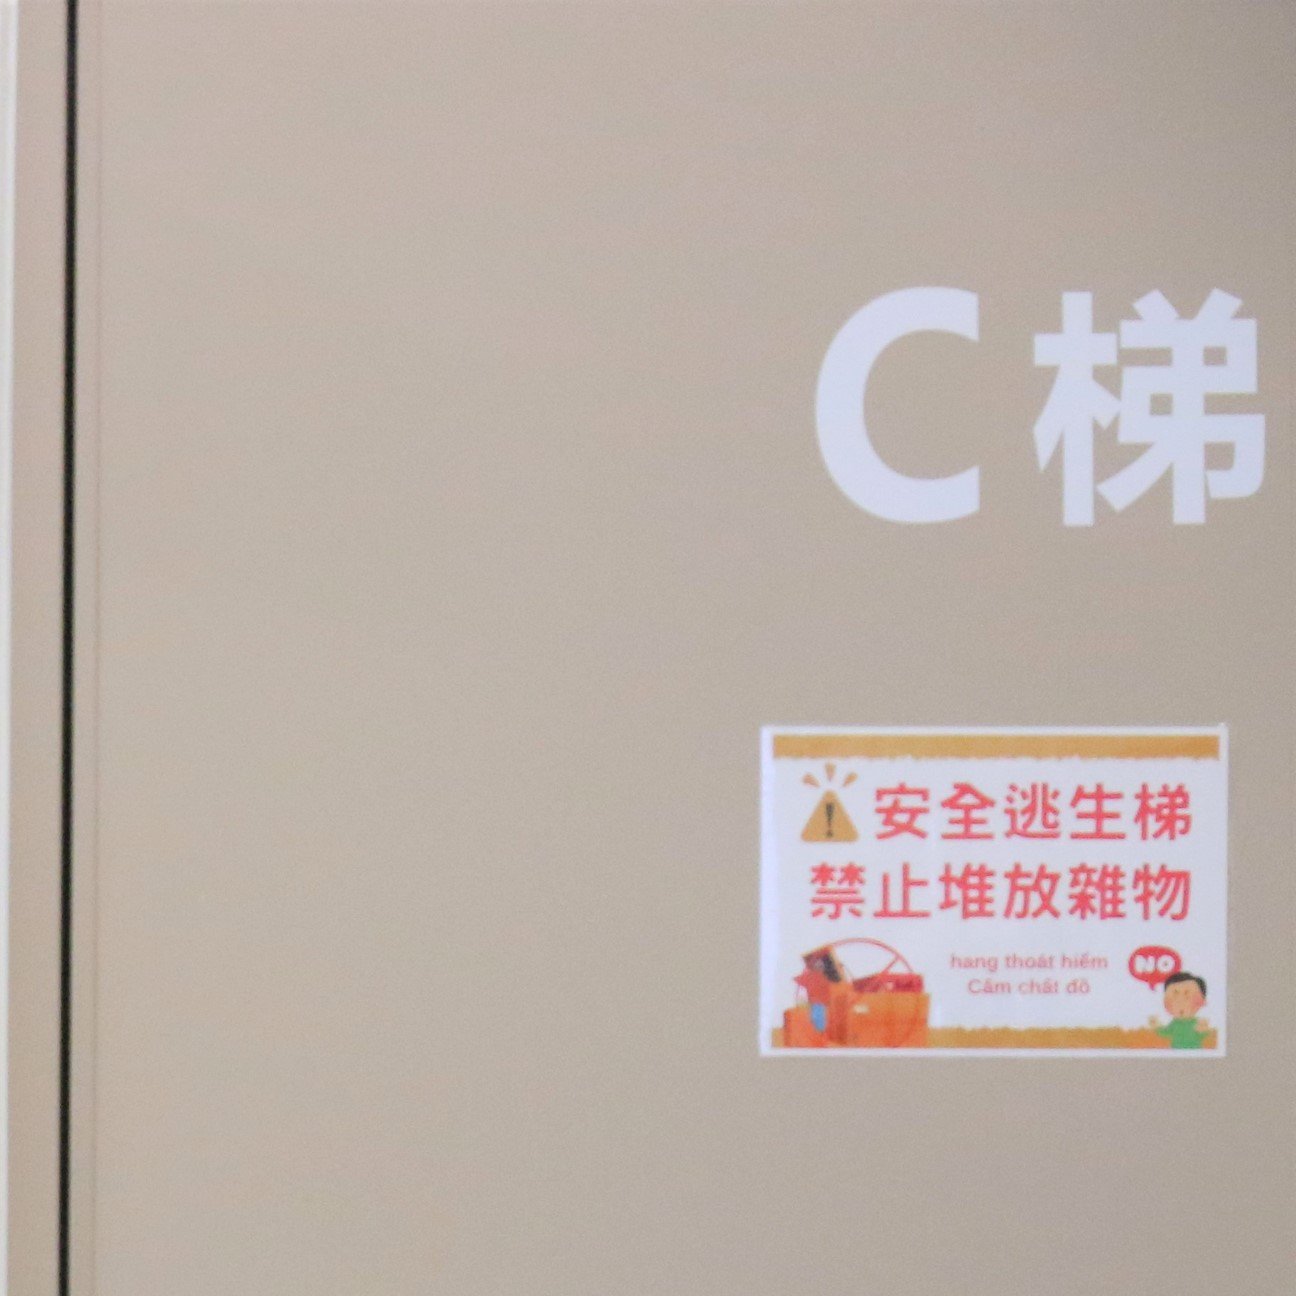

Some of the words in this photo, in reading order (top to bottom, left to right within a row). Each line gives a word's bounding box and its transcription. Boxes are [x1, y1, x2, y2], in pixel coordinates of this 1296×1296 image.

[875, 782, 1192, 841] 安全逃生梯
[811, 863, 1191, 921] 禁止堆放雜物
[1132, 951, 1176, 974] NO
